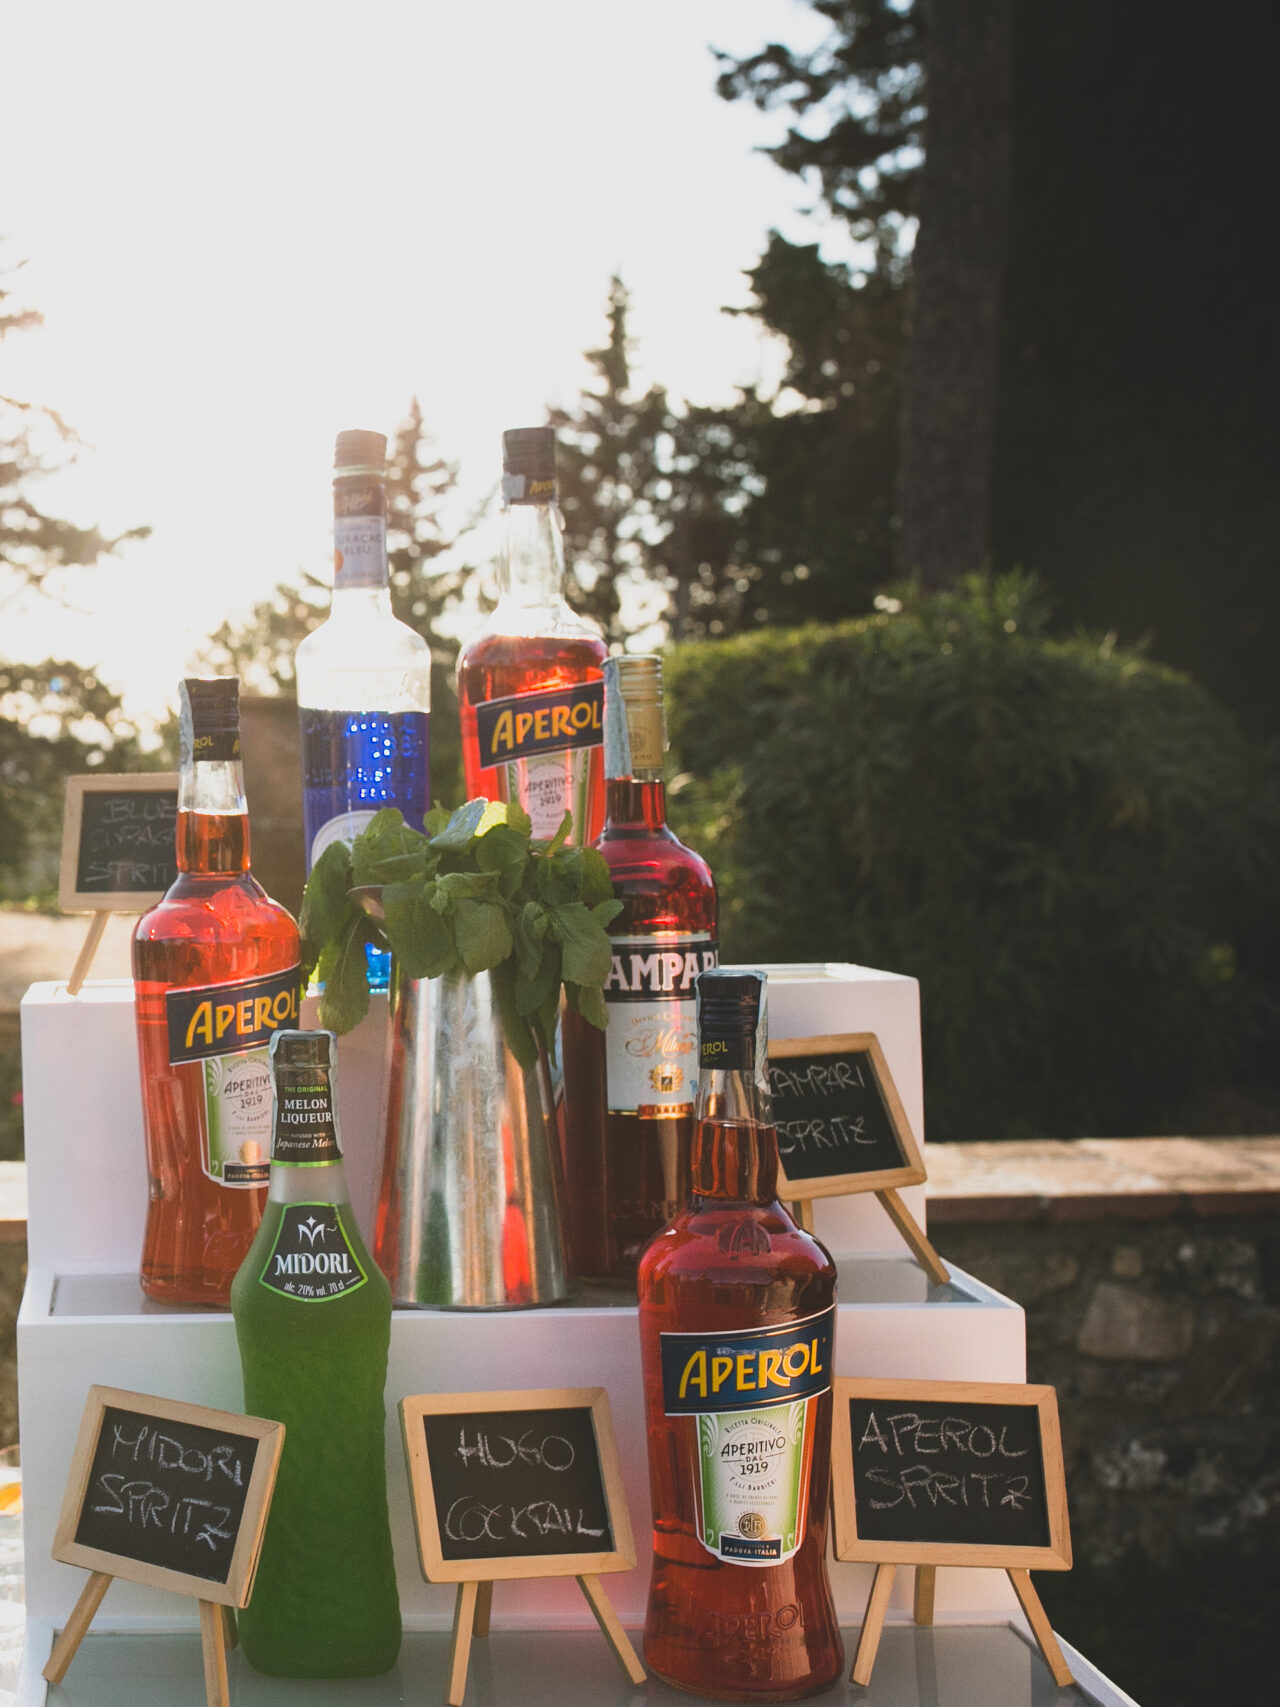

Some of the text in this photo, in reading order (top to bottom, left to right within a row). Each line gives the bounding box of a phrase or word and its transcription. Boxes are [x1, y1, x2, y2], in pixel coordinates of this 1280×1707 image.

[491, 701, 602, 753] APEROL
[603, 949, 719, 992] AMPARI
[185, 988, 298, 1048] APEROL
[701, 1040, 729, 1056] EROL
[241, 1095, 263, 1109] 1919
[280, 1112, 333, 1125] LIQUEUR
[284, 1098, 328, 1110] MELON
[276, 1137, 311, 1151] Japanese
[773, 1116, 878, 1154] SPRITZ
[283, 1281, 296, 1293] alc.
[297, 1284, 315, 1297] 20%
[316, 1285, 327, 1297] vol.
[678, 1338, 823, 1399] APEROL
[724, 1417, 782, 1435] RICETTA ORIGINALE
[858, 1411, 1029, 1458] APEROL
[111, 1424, 244, 1487] MIDORI
[455, 1425, 575, 1472] HUGO
[721, 1436, 786, 1457] APERITIVO
[745, 1454, 763, 1462] DAL
[740, 1461, 769, 1476] 1919
[864, 1464, 1033, 1511] SPRITZ
[92, 1473, 234, 1552] SPRITZ
[445, 1495, 606, 1541] COCKTAIL
